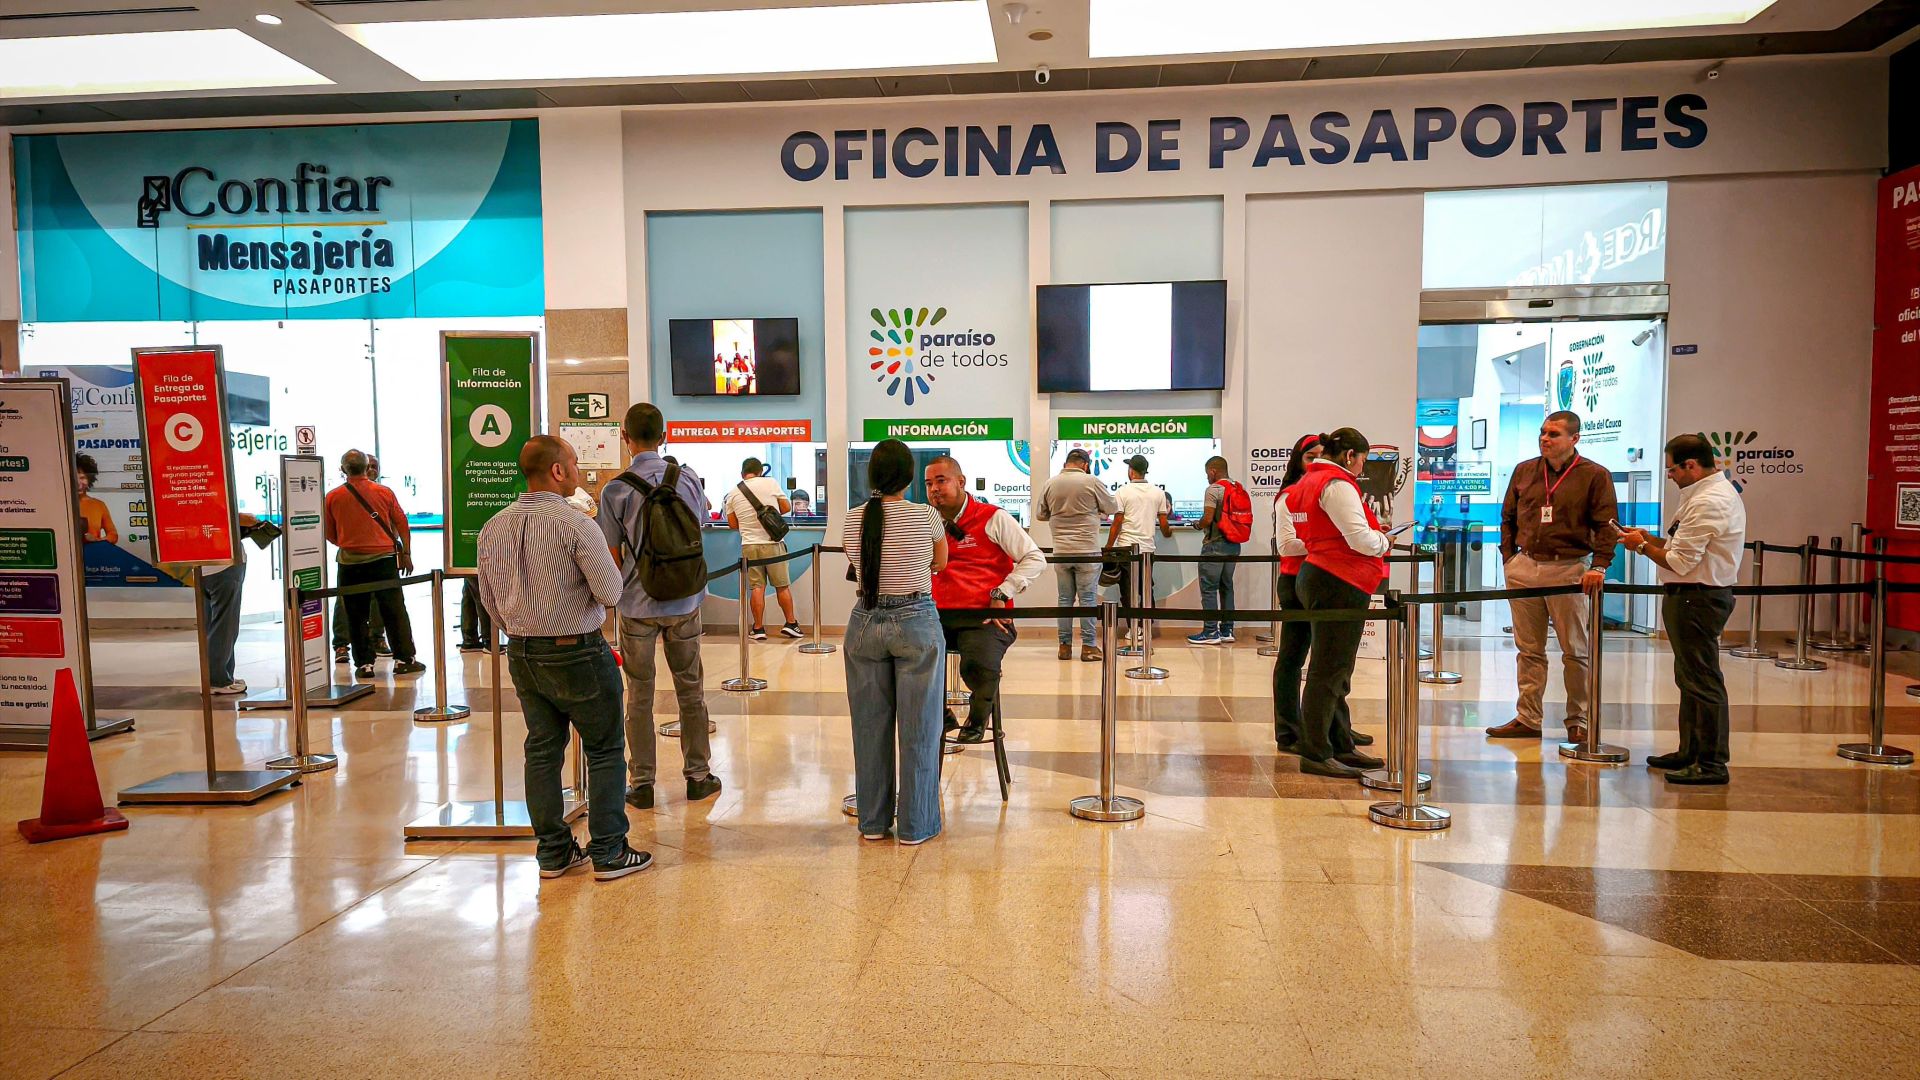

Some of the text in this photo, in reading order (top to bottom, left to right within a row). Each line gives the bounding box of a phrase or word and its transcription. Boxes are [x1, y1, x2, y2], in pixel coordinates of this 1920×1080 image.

[781, 93, 1708, 182] OFICINA DE PASAPORTES
[171, 162, 393, 217] Confiar
[1893, 181, 1920, 209] PA
[198, 228, 395, 275] Mensajería
[273, 276, 391, 295] PASAPORTES
[920, 328, 996, 351] paraíso
[920, 349, 1008, 367] de todos
[163, 373, 193, 383] Fila de
[472, 367, 506, 377] Fila de
[154, 383, 205, 394] Entrega de
[457, 378, 521, 388] Información
[153, 394, 207, 404] Pasaportes
[174, 421, 193, 442] C
[480, 413, 501, 435] A
[671, 426, 806, 437] ENTREGA DE PASAPORTES
[887, 420, 989, 437] INFORMACIÓN
[1083, 418, 1188, 435] INFORMACIÓN
[1103, 445, 1155, 455] de todos
[1736, 446, 1795, 462] paraíso
[466, 460, 491, 468] ¿Tienes
[1736, 460, 1804, 474] de todos
[465, 468, 498, 476] pregunta,
[476, 476, 513, 484] inquietud?
[1252, 475, 1281, 485] Valle
